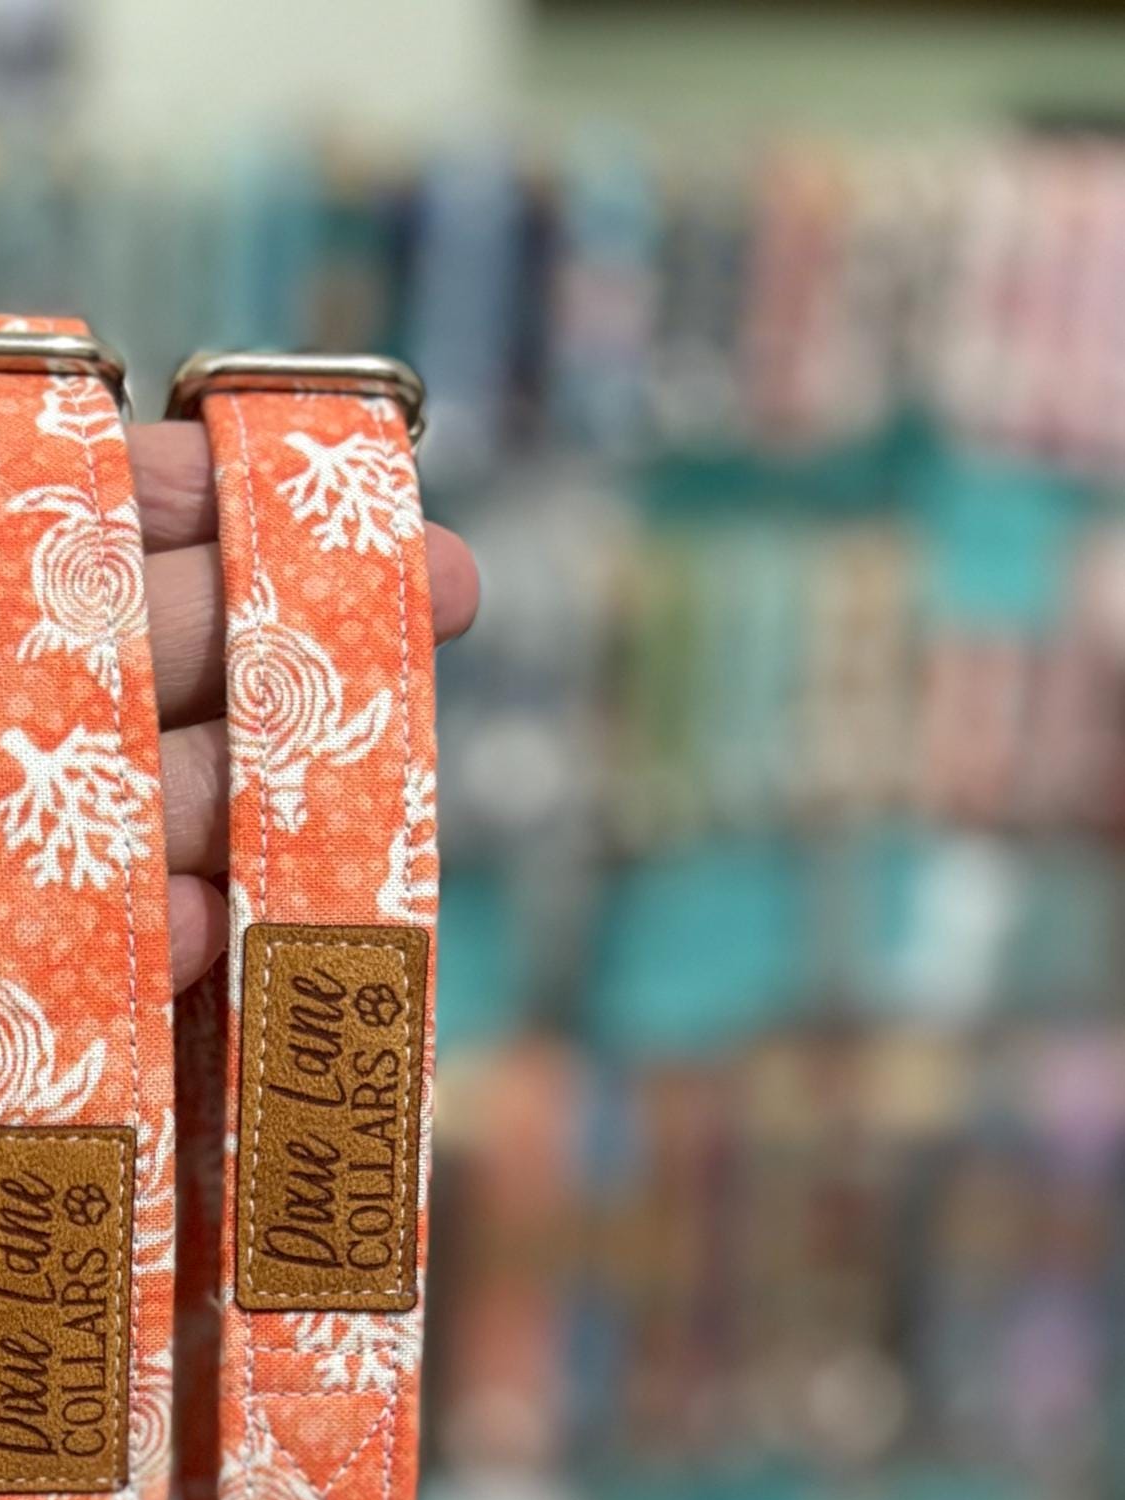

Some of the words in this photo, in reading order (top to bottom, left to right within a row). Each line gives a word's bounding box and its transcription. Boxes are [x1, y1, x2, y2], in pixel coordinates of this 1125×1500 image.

[267, 967, 347, 1109] Lane
[258, 1133, 343, 1269] Dixie
[346, 1049, 398, 1271] COLLARS
[59, 1247, 107, 1457] COLLARS
